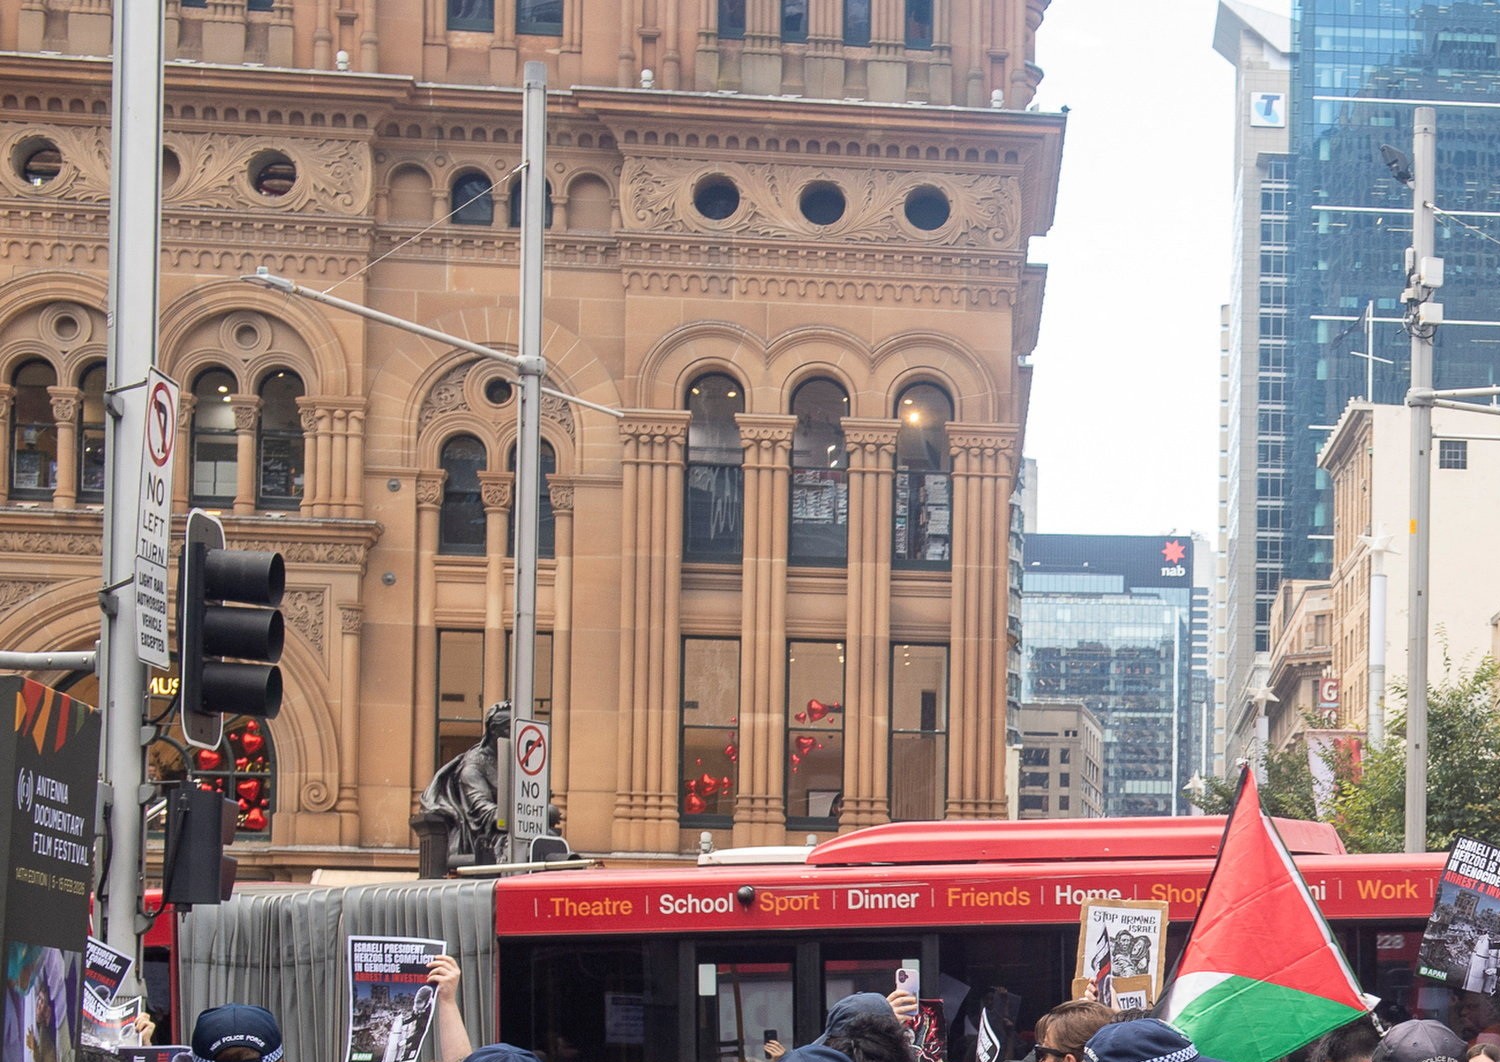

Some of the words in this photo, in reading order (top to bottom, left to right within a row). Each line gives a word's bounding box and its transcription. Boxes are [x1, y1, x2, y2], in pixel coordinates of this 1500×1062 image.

[147, 472, 165, 506] NO
[143, 509, 165, 538] LEFT
[141, 538, 165, 565] TURN
[139, 571, 152, 589] LIGHT
[1161, 565, 1185, 577] nab
[142, 612, 162, 632] VEHICLE
[140, 632, 165, 653] EXCEPTED
[36, 775, 69, 805] ANTENNA
[521, 780, 540, 799] NO
[517, 802, 544, 817] RIGHT
[34, 803, 85, 837] DOCUMENTARY
[518, 820, 543, 833] TURN
[32, 832, 53, 857] FILM
[53, 838, 89, 866] FESTIVAL
[1456, 837, 1491, 855] ISRAELI
[1447, 859, 1459, 872] IN
[1452, 849, 1486, 870] HERZOG
[1486, 861, 1498, 872] IS
[1357, 878, 1420, 900] Work
[1444, 871, 1476, 890] ARREST
[1477, 882, 1485, 892] &
[659, 893, 734, 915] School
[759, 891, 820, 915] Sport
[847, 889, 920, 909] Dinner
[947, 886, 1031, 908] Friends
[1055, 884, 1122, 905] Home
[550, 897, 633, 917] Theatre
[1093, 910, 1118, 923] STOP
[1121, 915, 1156, 925] ARMING
[1128, 924, 1157, 934] ISRAEL
[353, 942, 383, 954] ISRAELI
[384, 943, 425, 955] PRESIDENT
[353, 953, 383, 963] HERZOG
[385, 954, 393, 963] IS
[394, 954, 435, 965] COMPLICIT
[354, 963, 363, 973] IN
[364, 963, 401, 974] GENOCIDE
[1427, 968, 1448, 980] APAN
[222, 1034, 245, 1043] POLICE
[245, 1035, 266, 1048] FORCE
